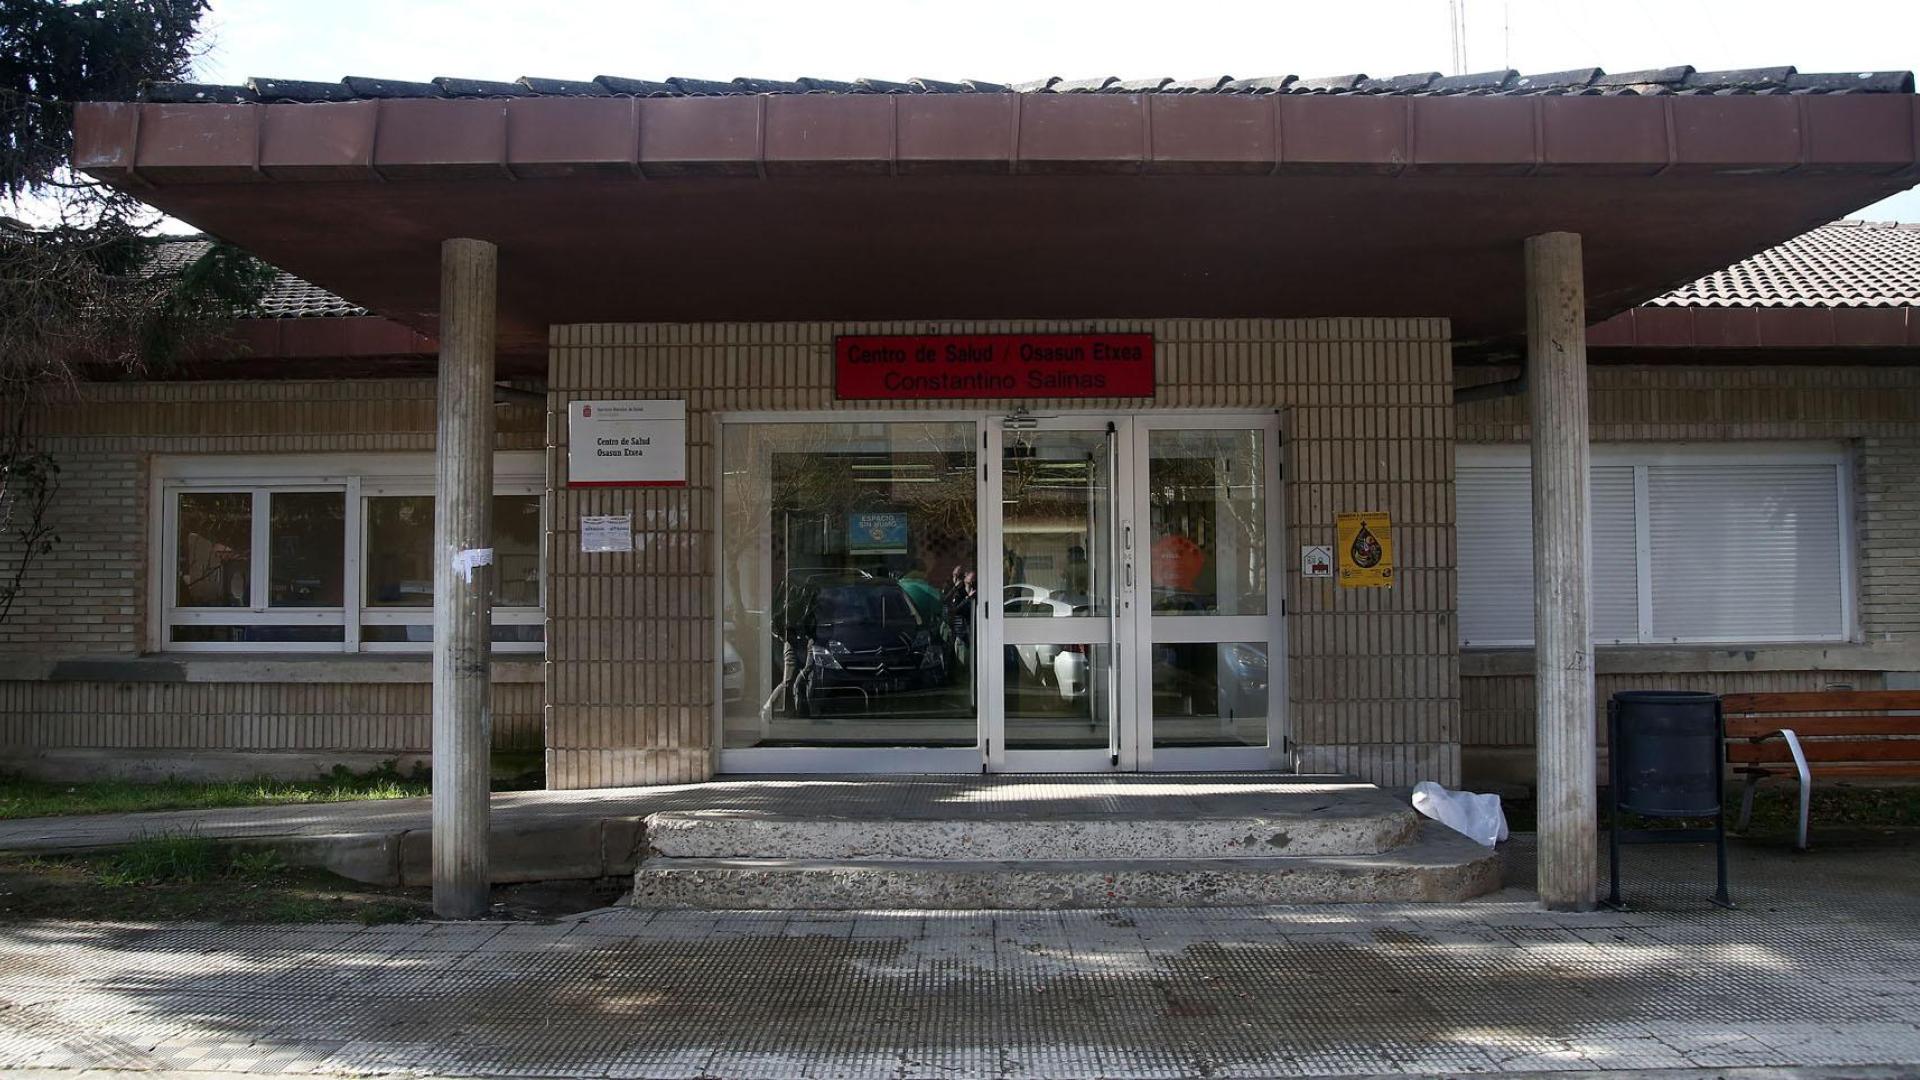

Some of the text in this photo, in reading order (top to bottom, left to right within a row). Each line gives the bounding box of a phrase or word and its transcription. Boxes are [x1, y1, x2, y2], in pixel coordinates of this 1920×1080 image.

[848, 342, 1143, 363] Centro de Salud / Osasun Etxea
[884, 369, 1107, 391] Constantino Salinas
[597, 437, 651, 446] Centro de Salud
[597, 448, 643, 457] Osasun Etxea
